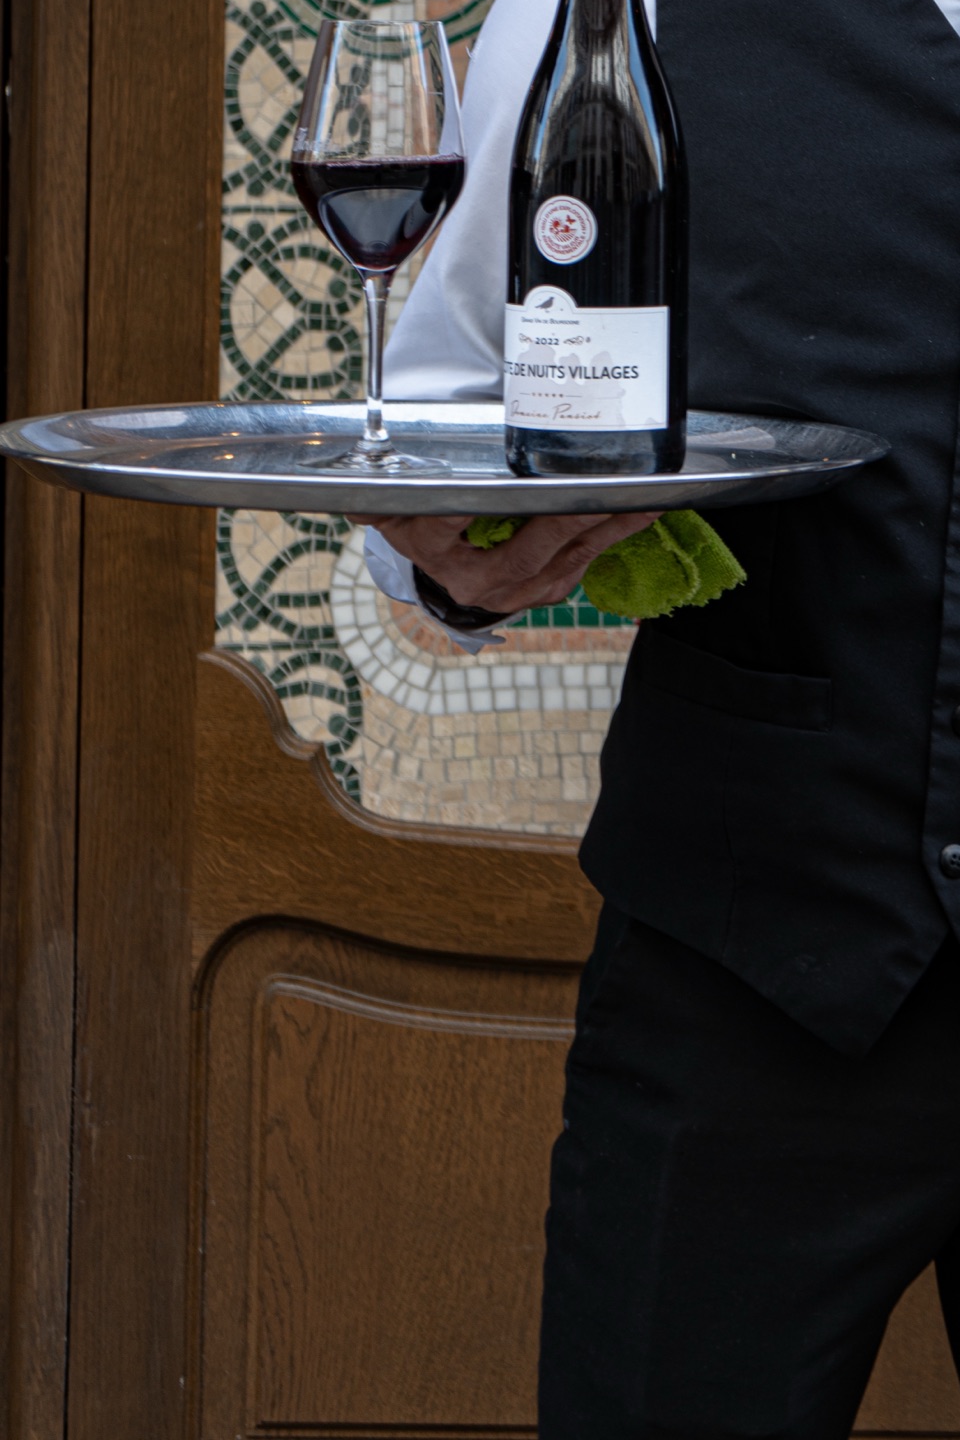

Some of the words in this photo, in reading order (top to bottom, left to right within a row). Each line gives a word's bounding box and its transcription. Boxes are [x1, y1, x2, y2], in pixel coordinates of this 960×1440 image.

[535, 337, 560, 346] 2022
[514, 362, 526, 377] DE
[528, 363, 566, 379] NUITS
[568, 365, 640, 380] VILLAGES
